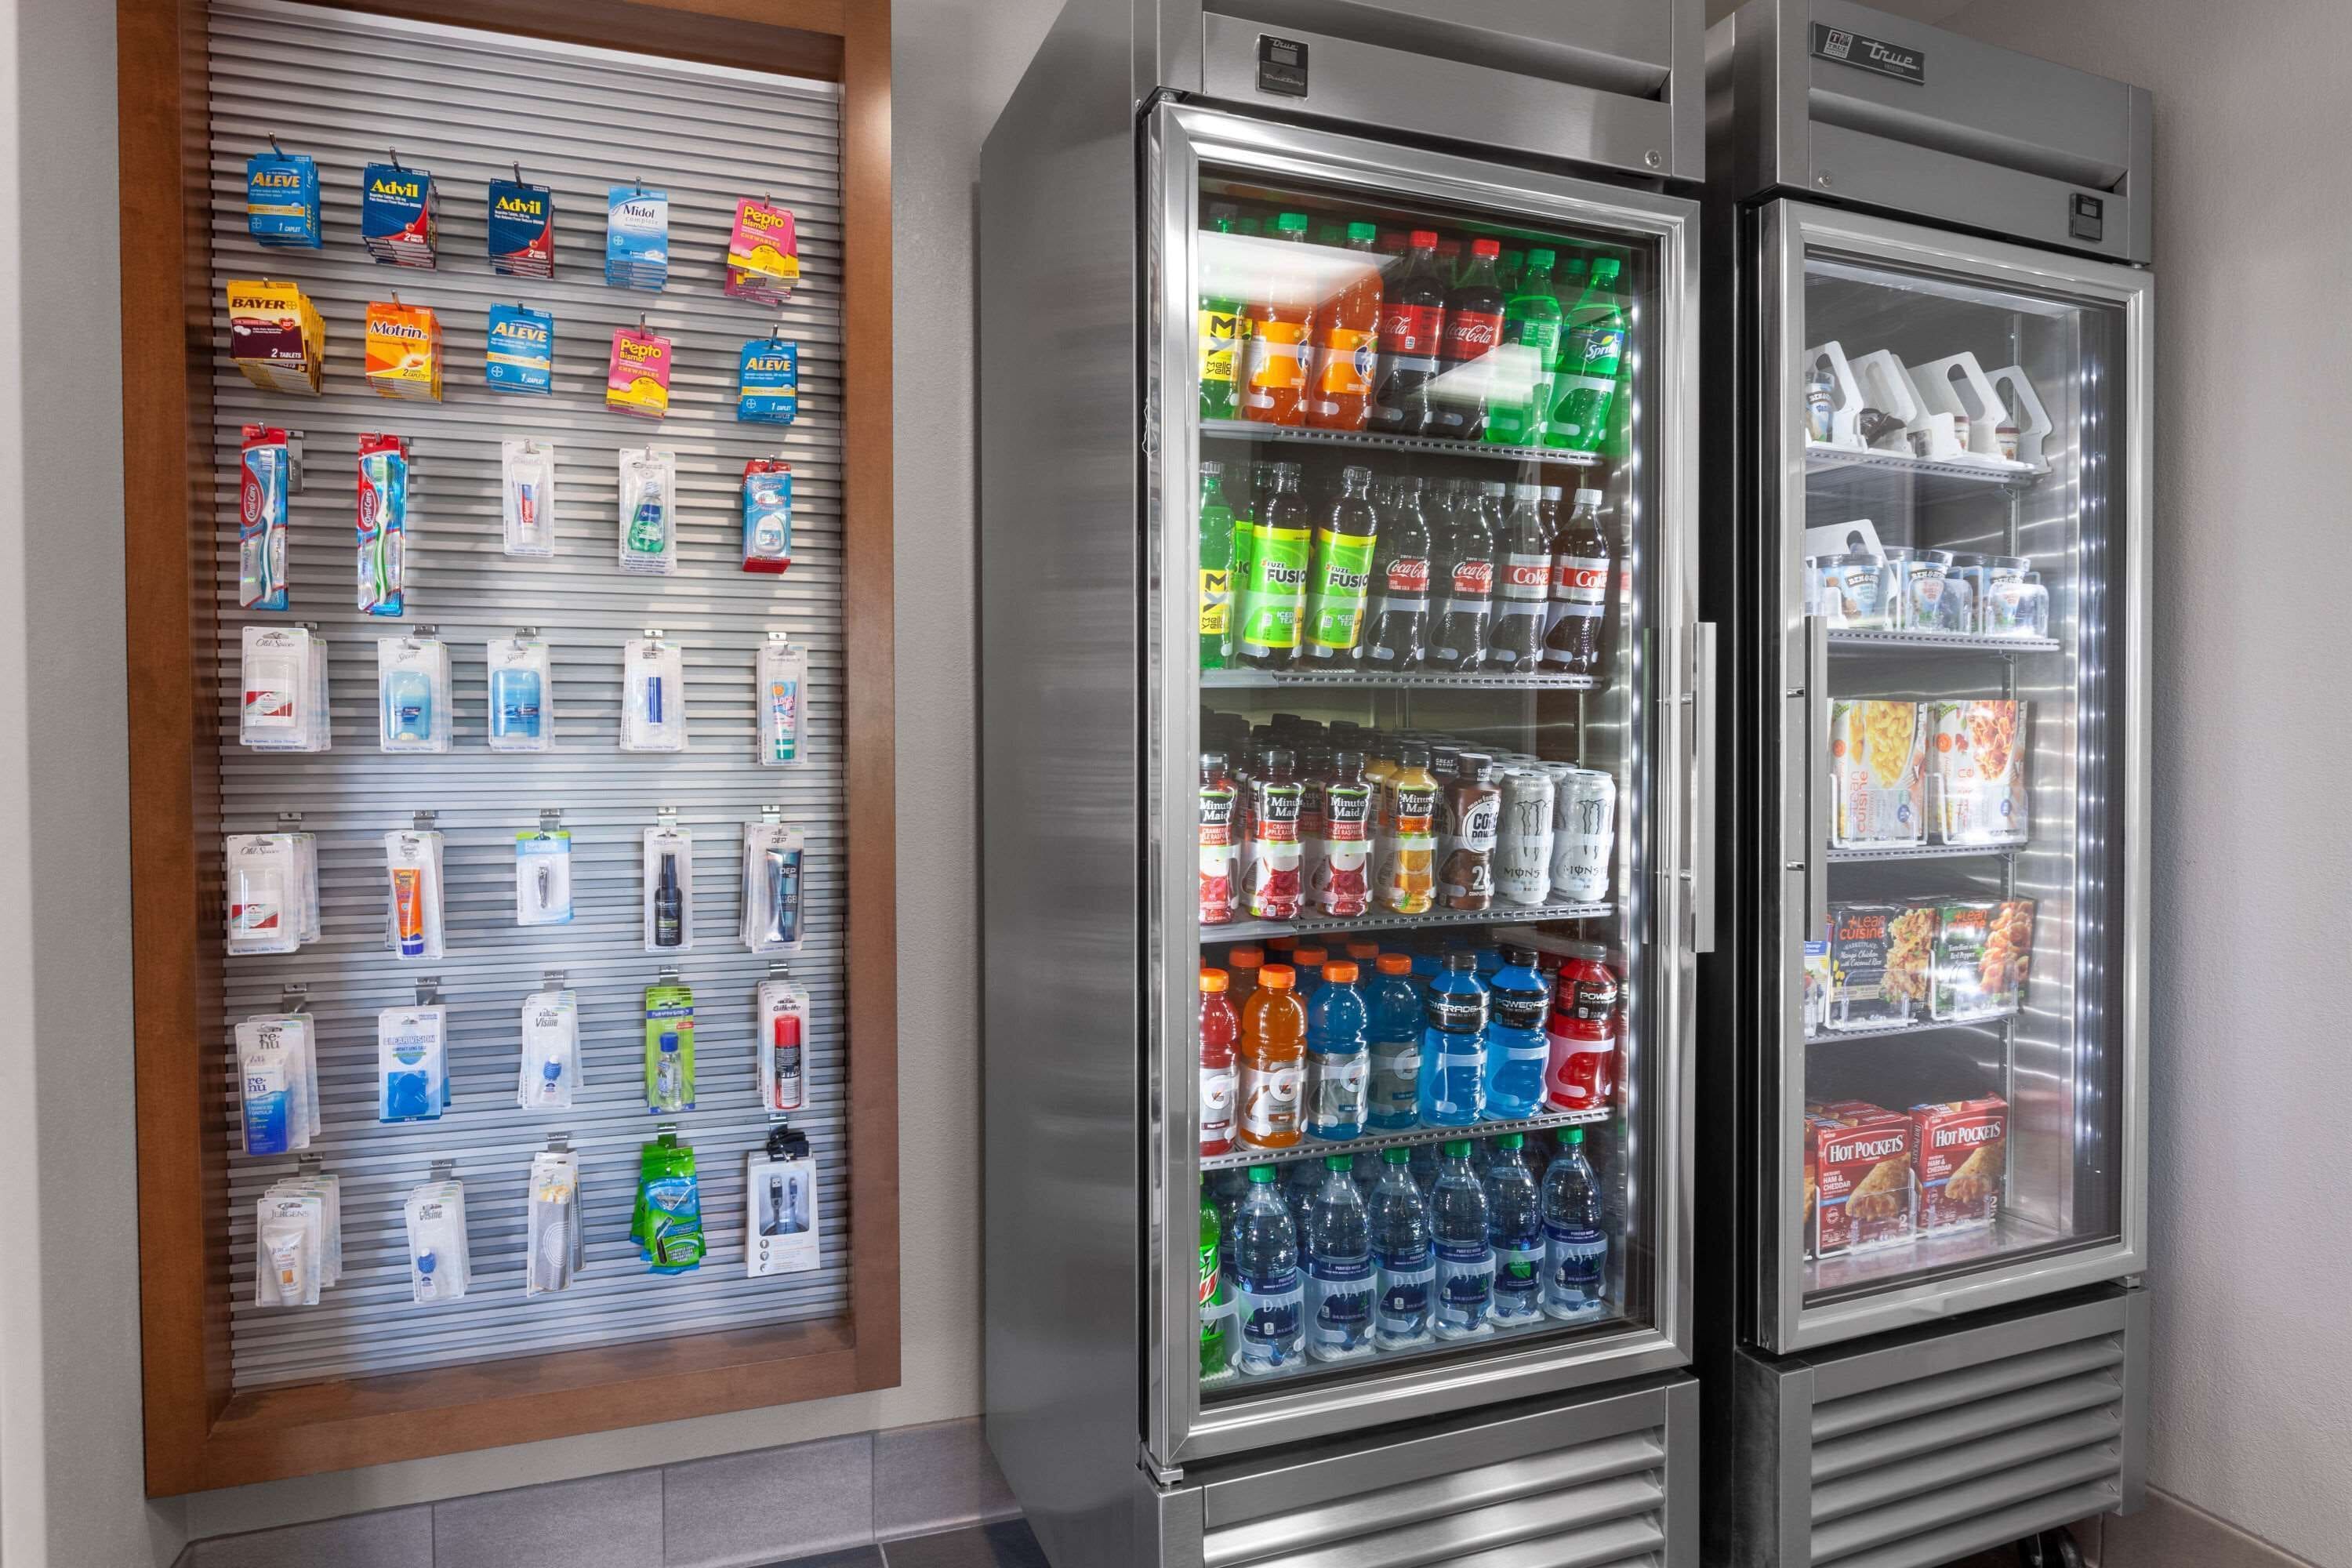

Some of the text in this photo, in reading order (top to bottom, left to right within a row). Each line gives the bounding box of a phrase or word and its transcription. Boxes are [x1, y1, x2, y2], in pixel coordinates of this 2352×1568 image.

[251, 172, 301, 187] ALEVE
[370, 179, 418, 198] Advil
[495, 196, 542, 215] Advil
[623, 205, 655, 218] Midol
[744, 206, 785, 228] Pepto
[278, 223, 283, 231] 1
[742, 218, 769, 230] Bismol
[404, 233, 411, 241] 2
[232, 299, 285, 309] BAYER
[371, 321, 422, 338] Motrin
[492, 321, 547, 343] ALEVE
[1446, 322, 1494, 343] Coca-Cola
[271, 348, 278, 358] 2
[621, 338, 662, 358] Pepto
[1585, 344, 1618, 359] Sprit
[619, 352, 647, 362] Bismol
[745, 358, 791, 371] ALEVE
[618, 366, 659, 378] CHEWABLES
[521, 374, 526, 383] 1
[1267, 568, 1306, 583] FUSIO
[1330, 574, 1369, 588] FUSIO
[1513, 567, 1548, 584] Coke
[1331, 796, 1365, 807] Minute
[1335, 807, 1360, 816] Maid
[1406, 804, 1431, 812] Maid
[1504, 866, 1541, 878] MONS
[1430, 1000, 1477, 1012] OWERADE
[535, 1016, 558, 1028] Visine
[1936, 1121, 2001, 1147] HOT POCKETS
[1830, 1135, 1904, 1163] HOT POCKETS
[1927, 1164, 1952, 1174] CHEDDAR
[1824, 1176, 1837, 1185] HAM
[1824, 1181, 1851, 1191] CHEDDAR
[1990, 1196, 1998, 1208] 2
[419, 1210, 443, 1220] Visine
[1899, 1214, 1907, 1227] 2
